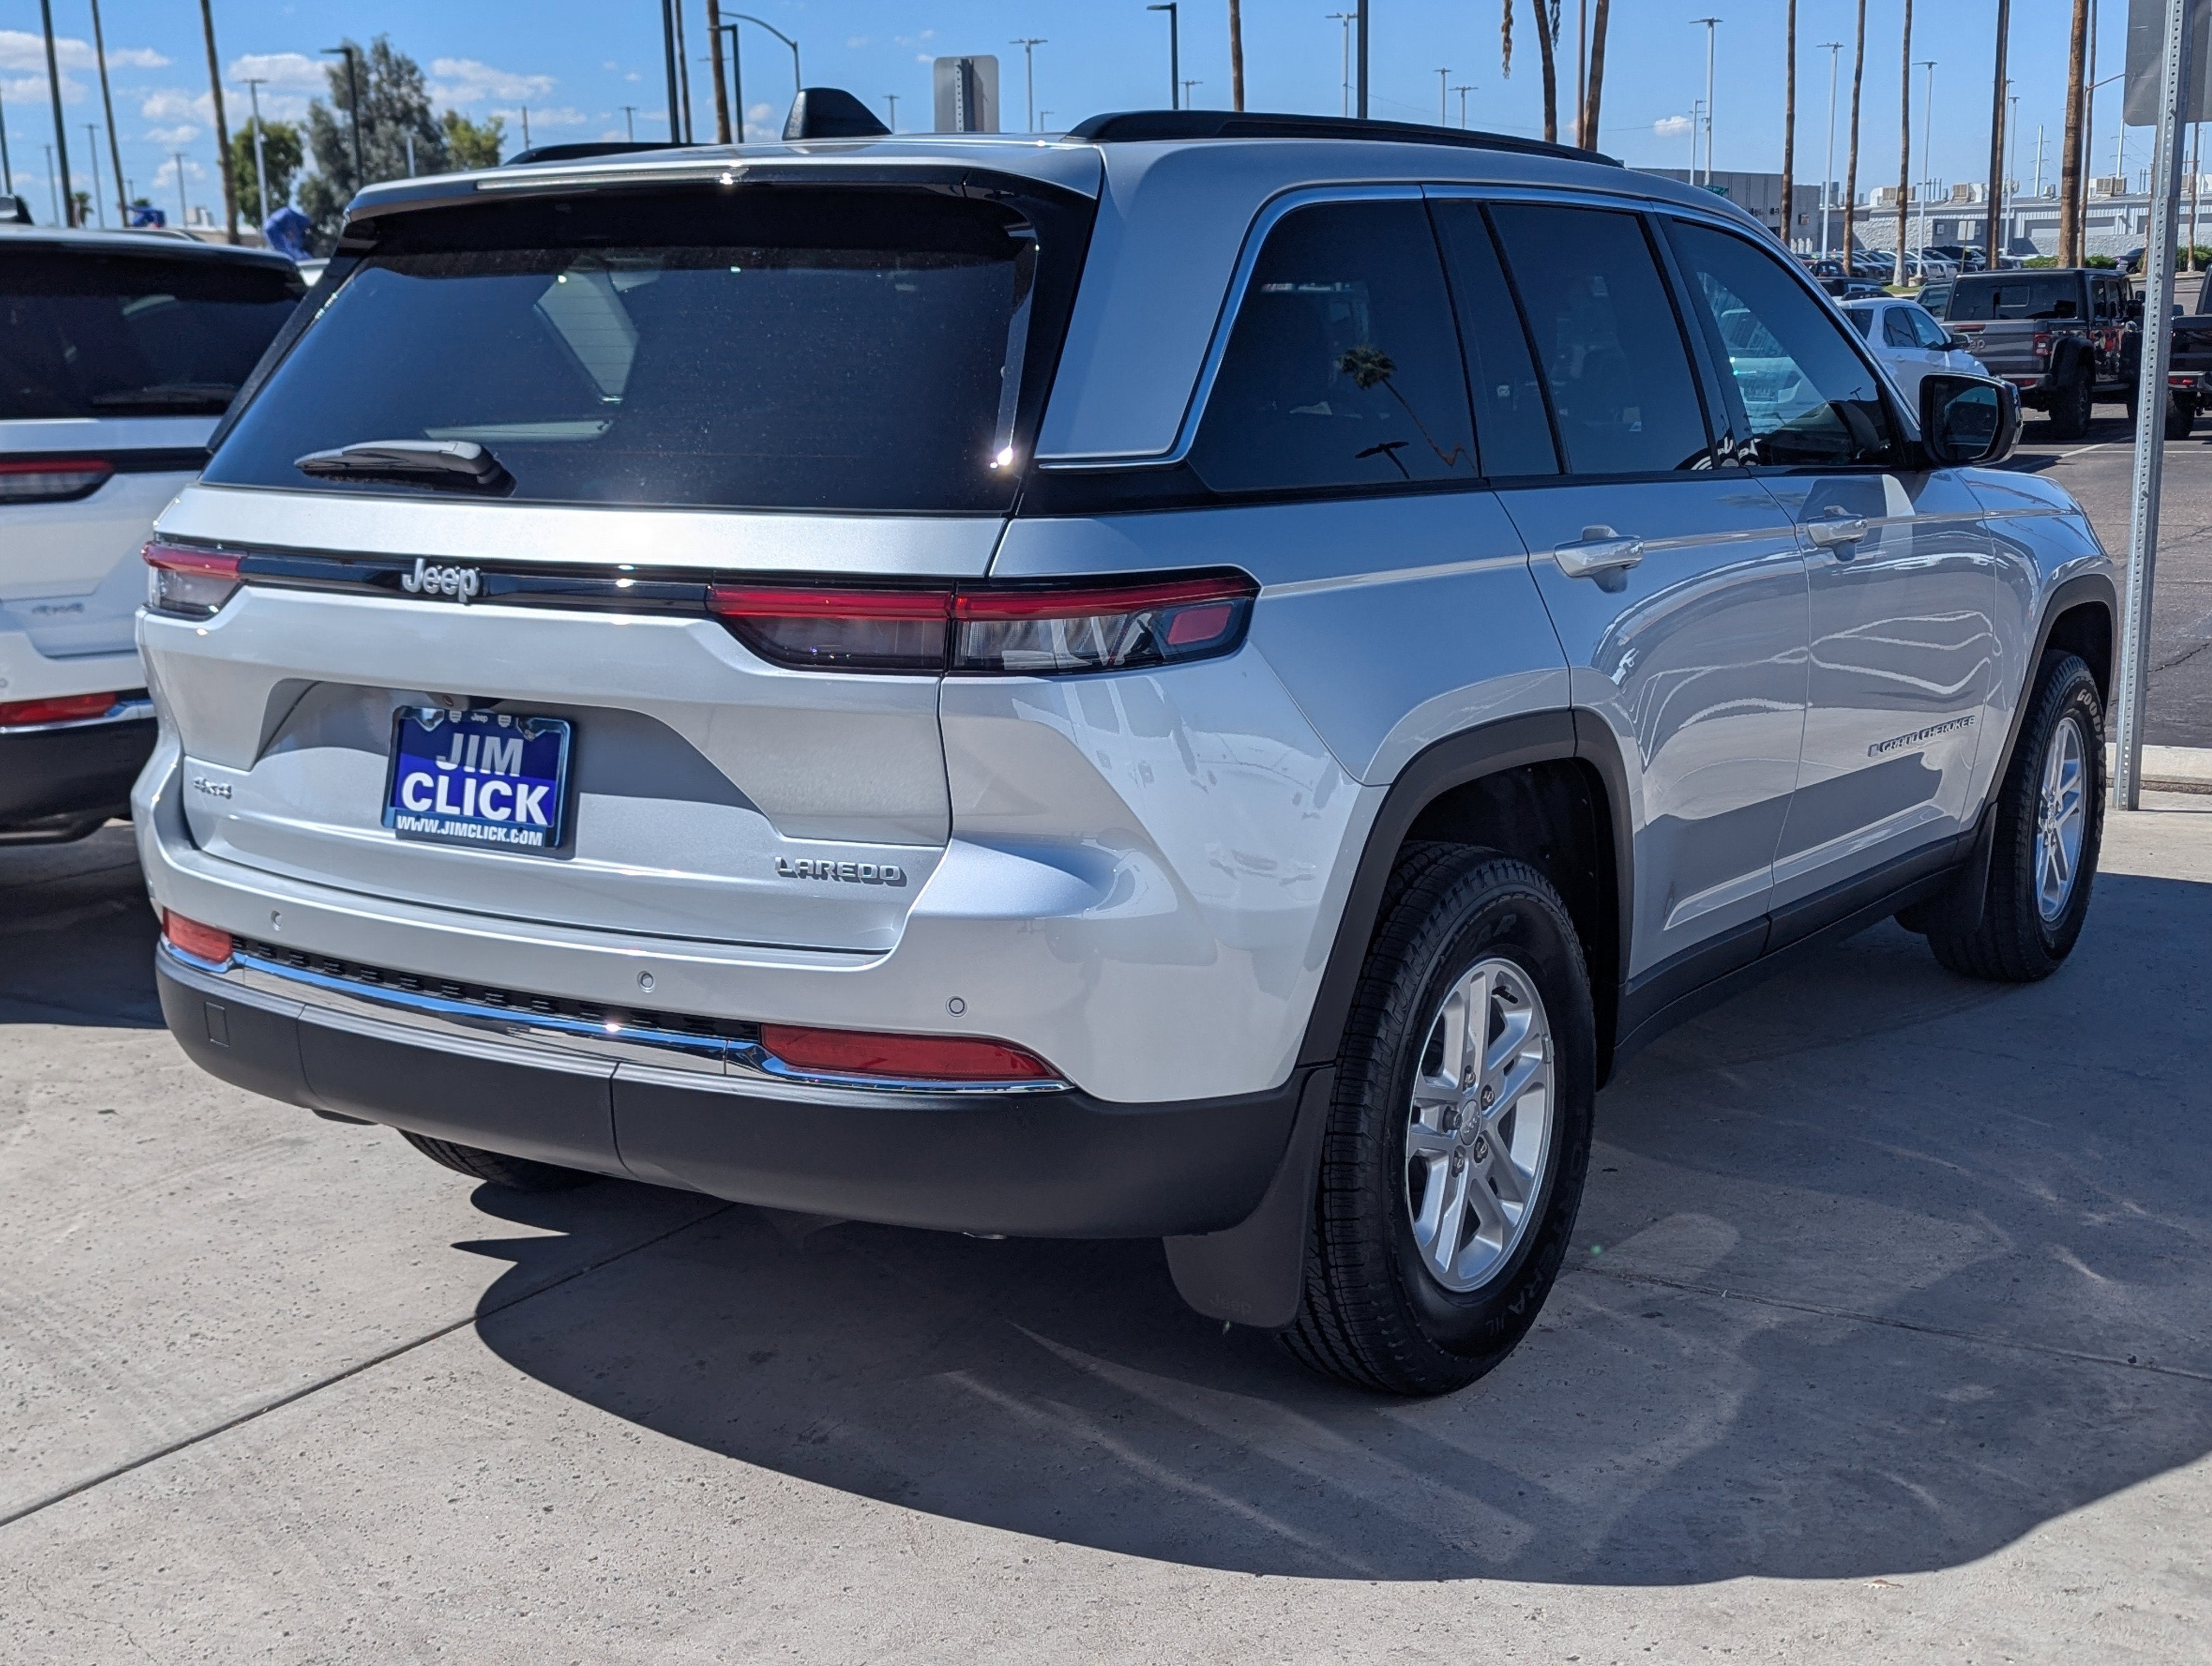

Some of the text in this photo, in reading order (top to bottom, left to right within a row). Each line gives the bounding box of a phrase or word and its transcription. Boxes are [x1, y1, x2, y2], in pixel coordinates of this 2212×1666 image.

[402, 558, 479, 603] Jeep
[435, 732, 524, 777] JIM
[1880, 715, 1976, 753] GRAND CHEROKEE
[401, 772, 550, 825] CLICK
[397, 815, 542, 847] WWW.JIMCLICK.COM
[775, 856, 903, 883] LAREDO
